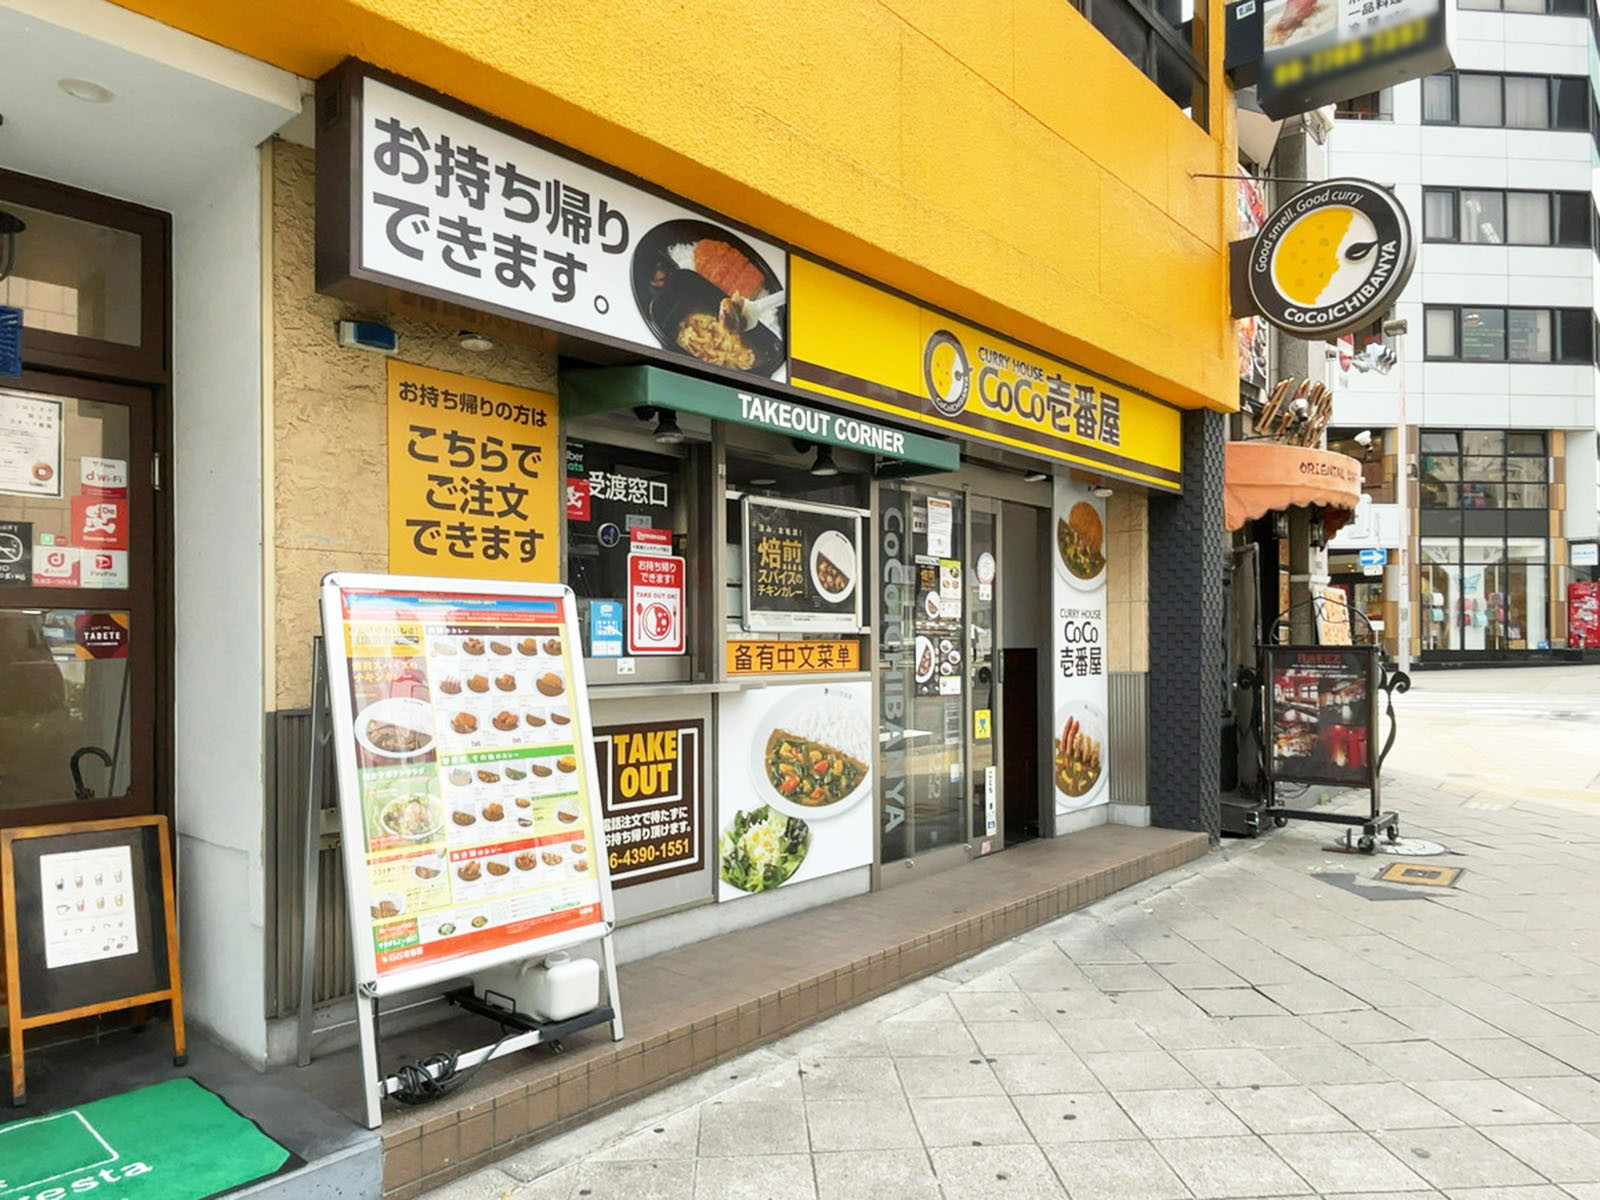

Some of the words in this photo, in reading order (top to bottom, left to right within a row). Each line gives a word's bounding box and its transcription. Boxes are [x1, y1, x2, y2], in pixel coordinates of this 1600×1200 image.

[373, 116, 629, 255] お持ち帰り
[1255, 238, 1272, 273] Good
[1269, 208, 1297, 240] smell.
[1296, 189, 1331, 213] Good
[1331, 189, 1364, 205] curry
[373, 192, 609, 315] できます。
[977, 346, 1010, 370] CURRY
[1012, 359, 1044, 382] HOUSE
[399, 381, 547, 427] お持ち帰りの方は
[978, 365, 1120, 447] CoCo壱番屋
[737, 393, 831, 437] TAKEOUT
[834, 419, 905, 454] CORNER
[407, 424, 542, 479] こちらで
[426, 473, 529, 521] ご注文
[588, 471, 668, 507] 受渡窓口
[405, 518, 544, 563] できます
[757, 536, 802, 571] 焙煎
[638, 560, 677, 573] お持ち帰り
[757, 569, 803, 585] スパイスの
[757, 584, 803, 598] チキンカレー
[1059, 608, 1079, 619] CURRY
[1081, 608, 1102, 620] HOUSE
[1064, 621, 1098, 643] CoCo
[734, 644, 851, 671] 备有中文菜单
[1059, 646, 1102, 678] 壱番屋
[613, 729, 678, 765] TAKE
[620, 762, 673, 798] OUT
